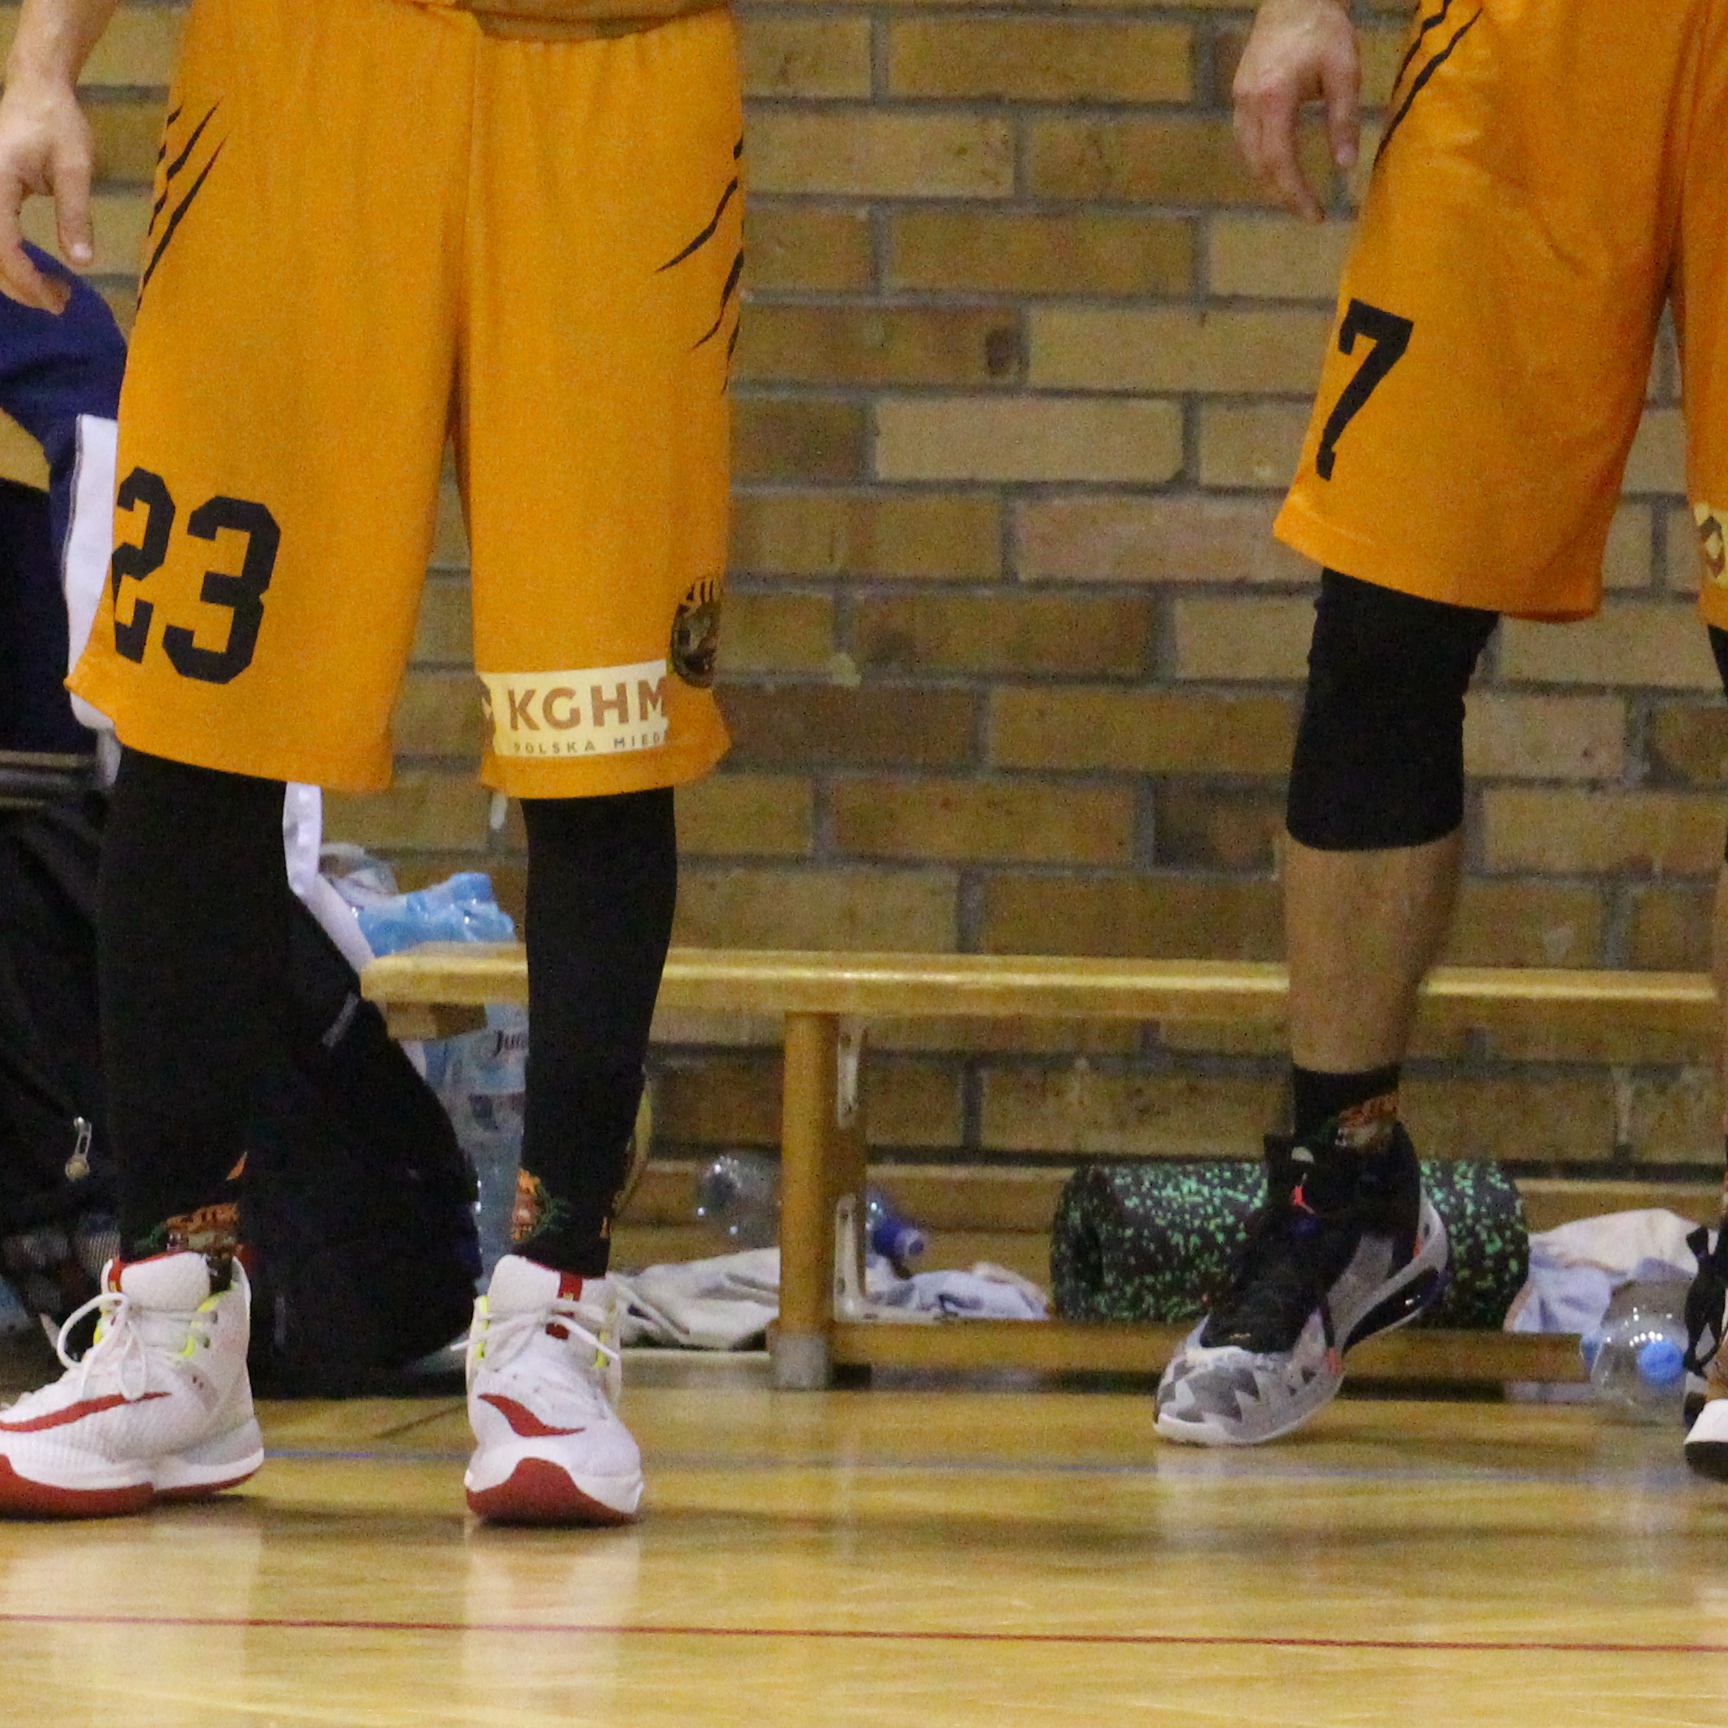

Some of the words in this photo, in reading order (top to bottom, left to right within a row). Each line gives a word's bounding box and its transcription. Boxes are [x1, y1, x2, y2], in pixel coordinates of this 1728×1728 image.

[1317, 298, 1414, 482] 7
[112, 468, 281, 685] 23
[508, 678, 667, 731] KGHM
